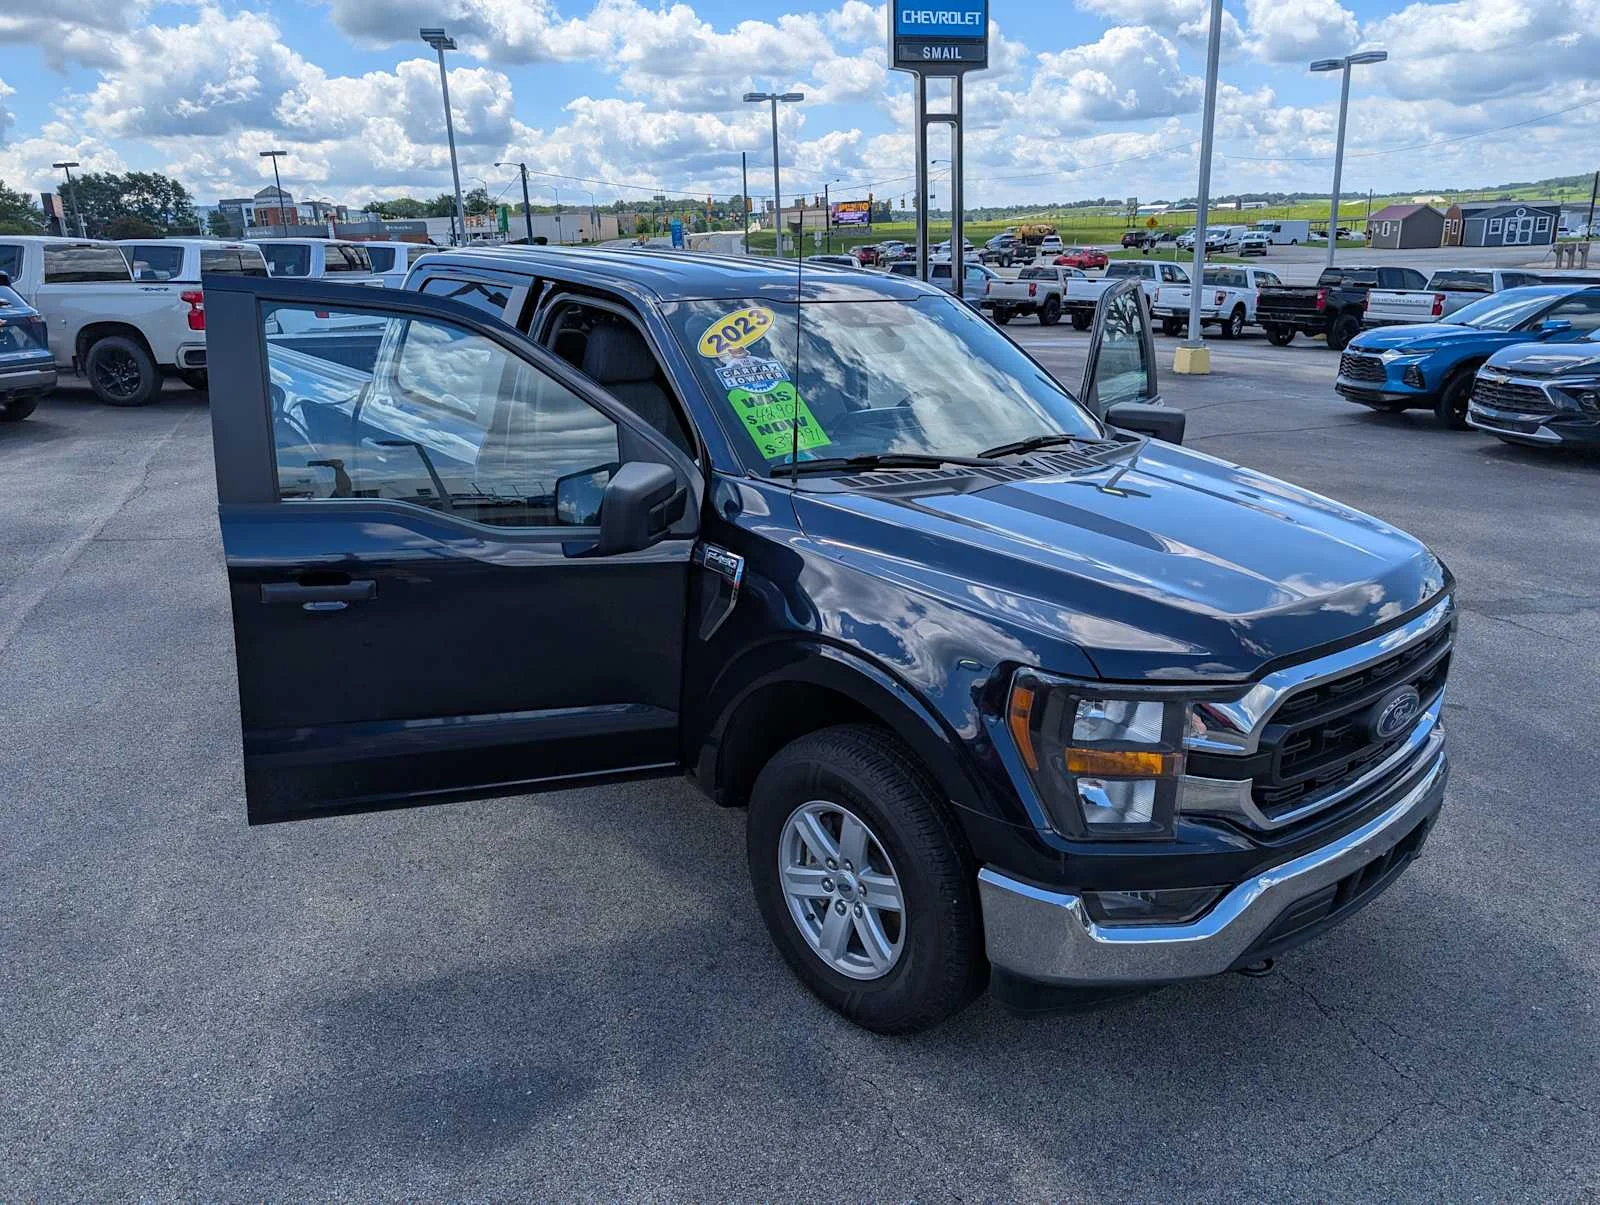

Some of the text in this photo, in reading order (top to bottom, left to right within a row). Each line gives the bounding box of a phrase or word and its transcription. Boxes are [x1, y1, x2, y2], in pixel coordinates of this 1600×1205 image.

[902, 10, 982, 25] CHEVROLET
[923, 47, 962, 59] SMAIL
[707, 310, 769, 353] 2023
[722, 365, 779, 378] CARFAX
[737, 372, 784, 384] OWNER
[741, 391, 792, 408] WAS
[757, 416, 808, 436] NOW
[1391, 702, 1418, 726] Ford
